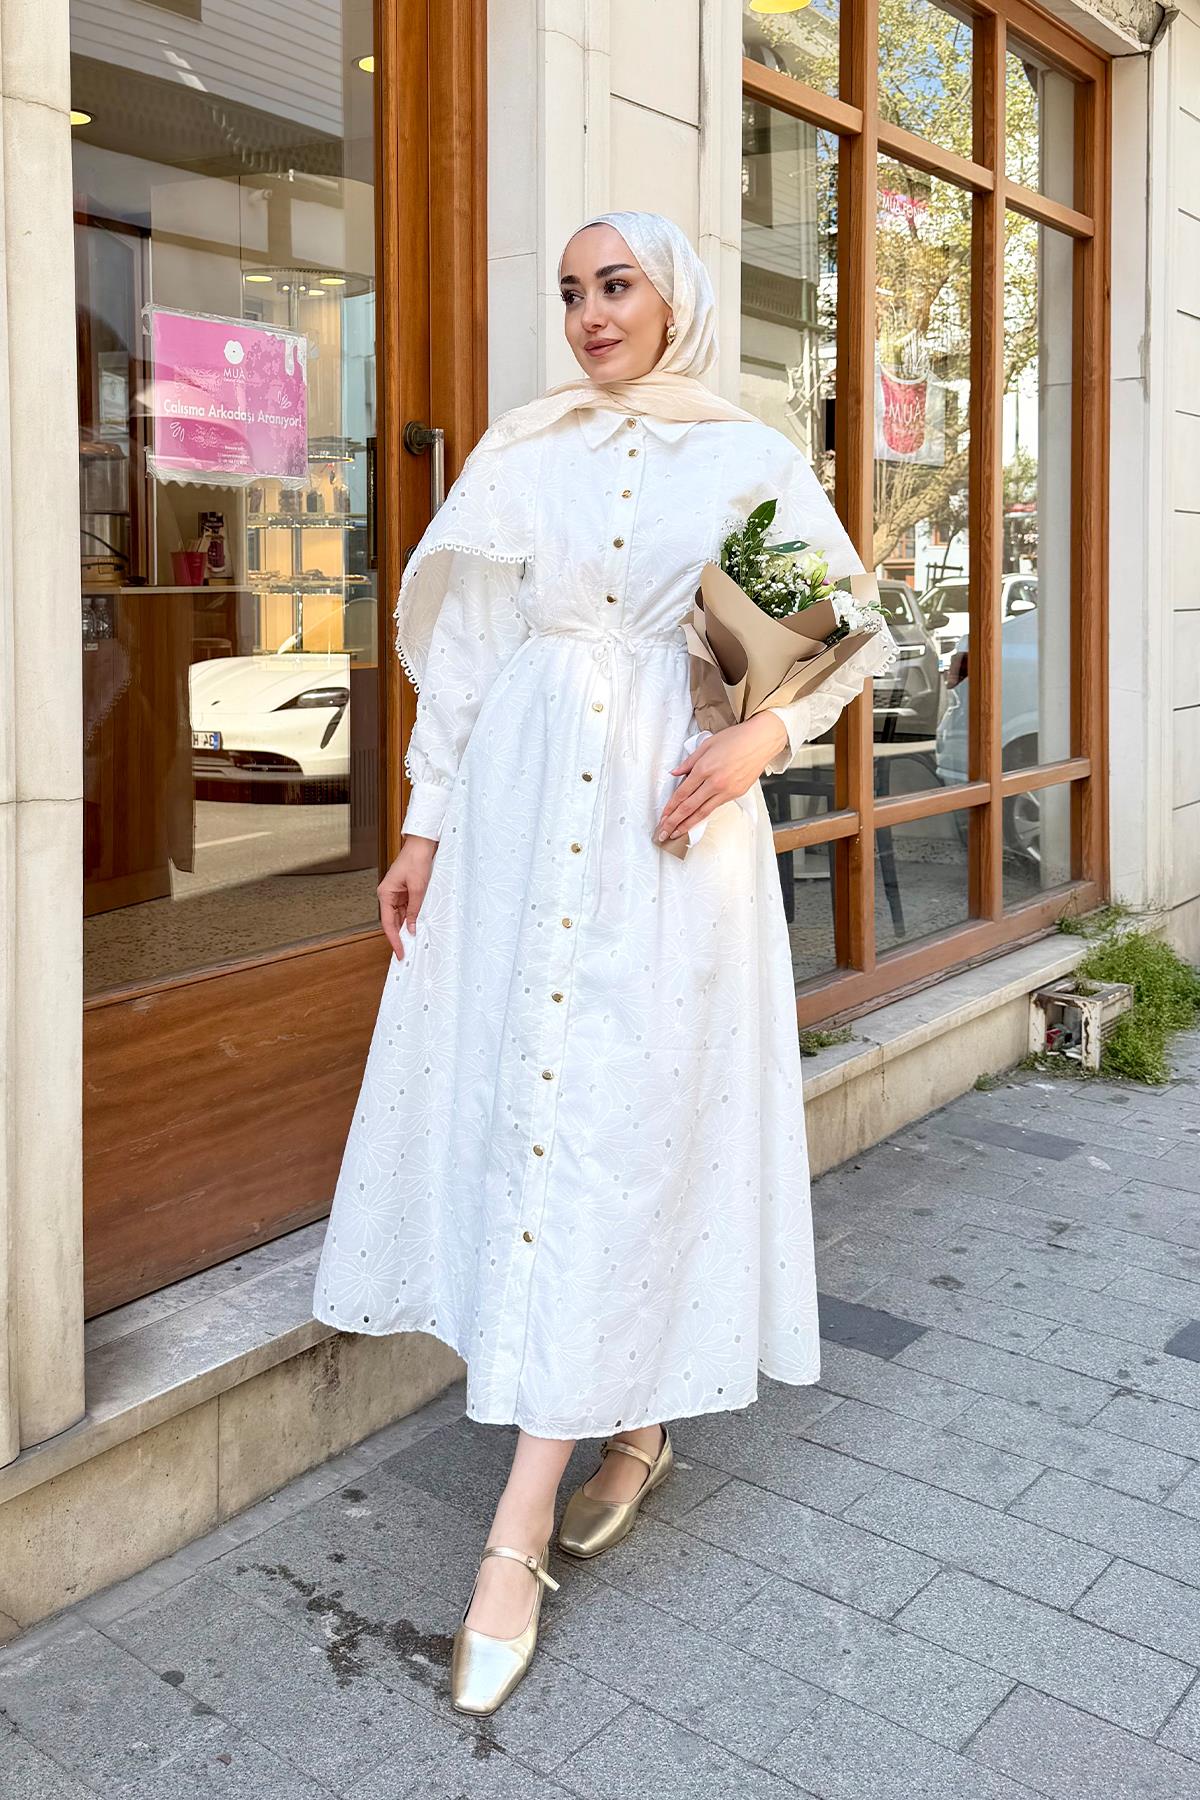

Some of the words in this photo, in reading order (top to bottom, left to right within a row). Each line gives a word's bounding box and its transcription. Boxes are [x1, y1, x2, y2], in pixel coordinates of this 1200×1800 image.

[163, 400, 205, 417] Çalışma
[208, 404, 255, 423] Arkadaşı
[257, 410, 302, 429] Aranıyor!
